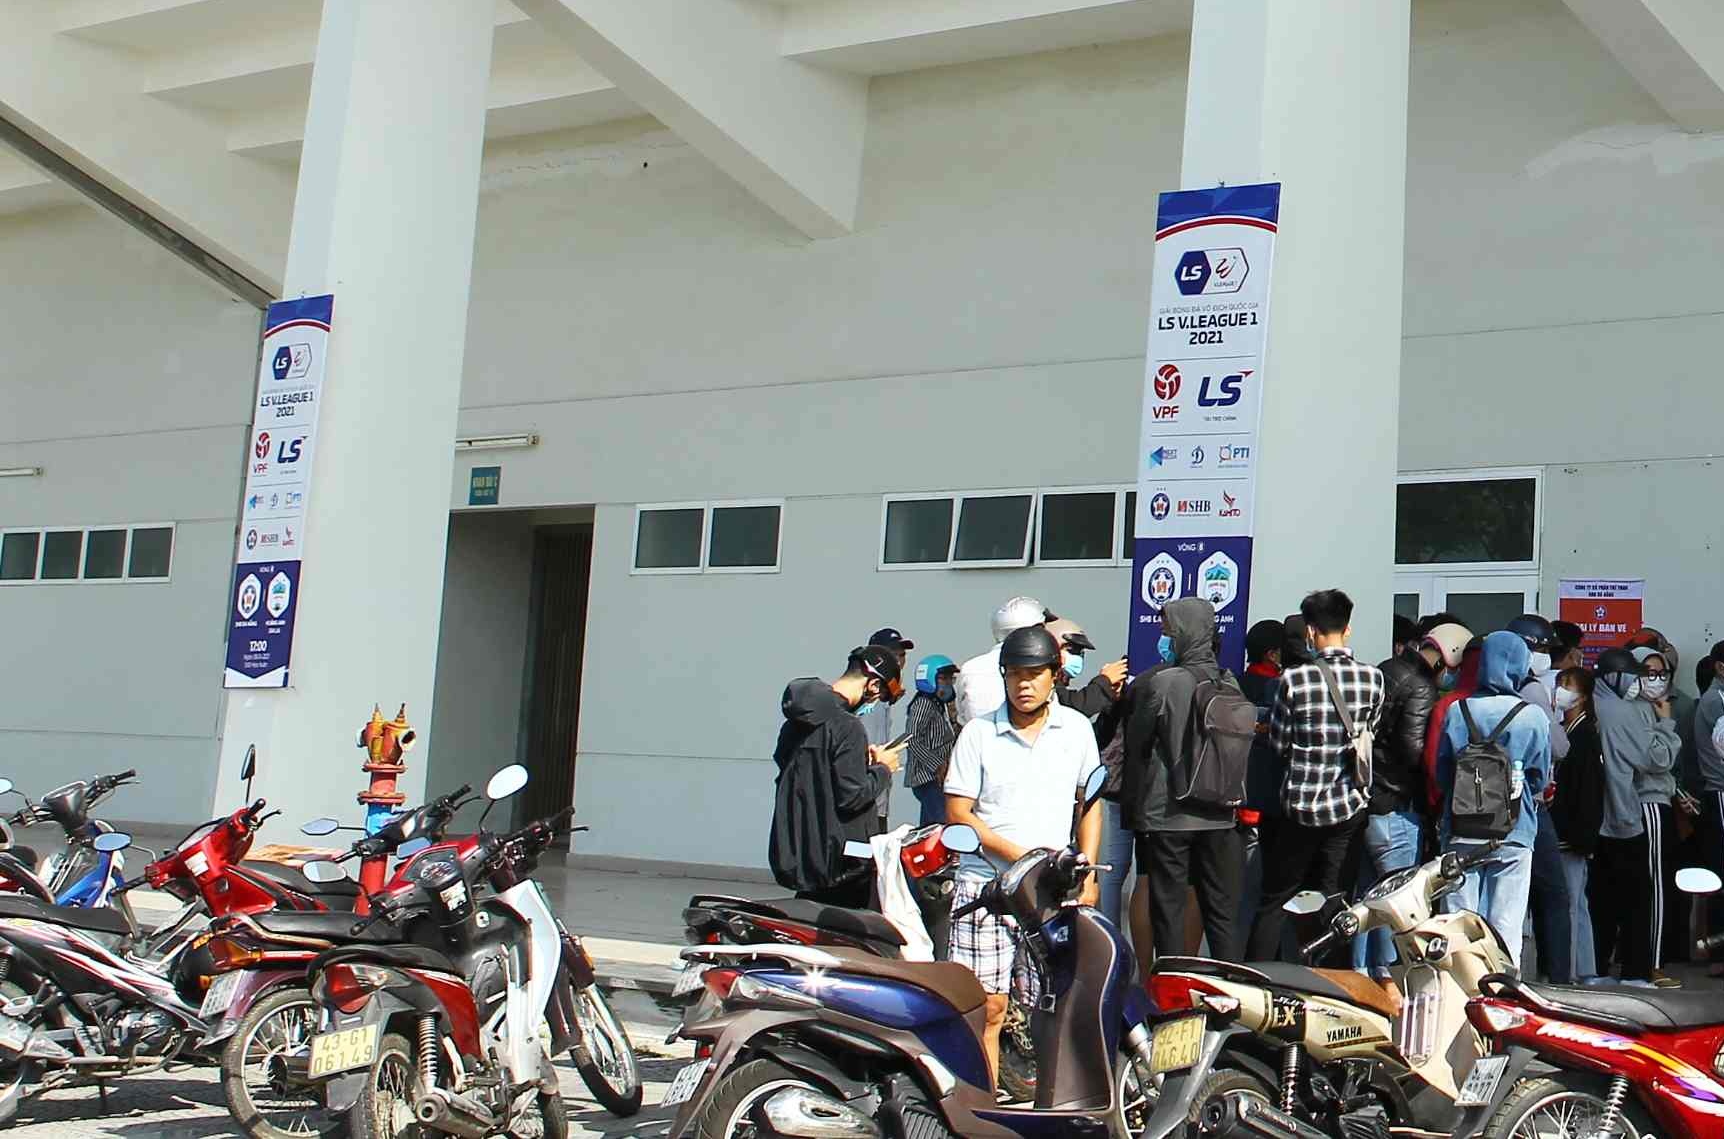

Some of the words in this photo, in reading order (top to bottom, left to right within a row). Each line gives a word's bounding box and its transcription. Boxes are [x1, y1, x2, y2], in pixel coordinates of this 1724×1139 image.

[1180, 265, 1203, 281] LS
[1158, 316, 1175, 330] LS
[1178, 313, 1247, 330] V.LEAGUE
[1250, 312, 1258, 325] 1
[1189, 330, 1224, 345] 2021
[275, 358, 288, 369] LS
[1197, 375, 1243, 407] LS
[260, 396, 270, 407] LS
[271, 392, 308, 406] V.LEAGUE
[276, 406, 295, 417] 2021
[1152, 406, 1179, 419] VPF
[277, 439, 302, 463] LS
[1233, 447, 1249, 459] PTI
[253, 463, 268, 473] VPF
[1189, 500, 1210, 512] SHB
[1220, 615, 1234, 623] ANH
[1272, 1006, 1296, 1027] LX
[323, 1028, 367, 1051] 43-G1
[1327, 1026, 1362, 1043] YAMAHA
[314, 1045, 373, 1074] 061.49
